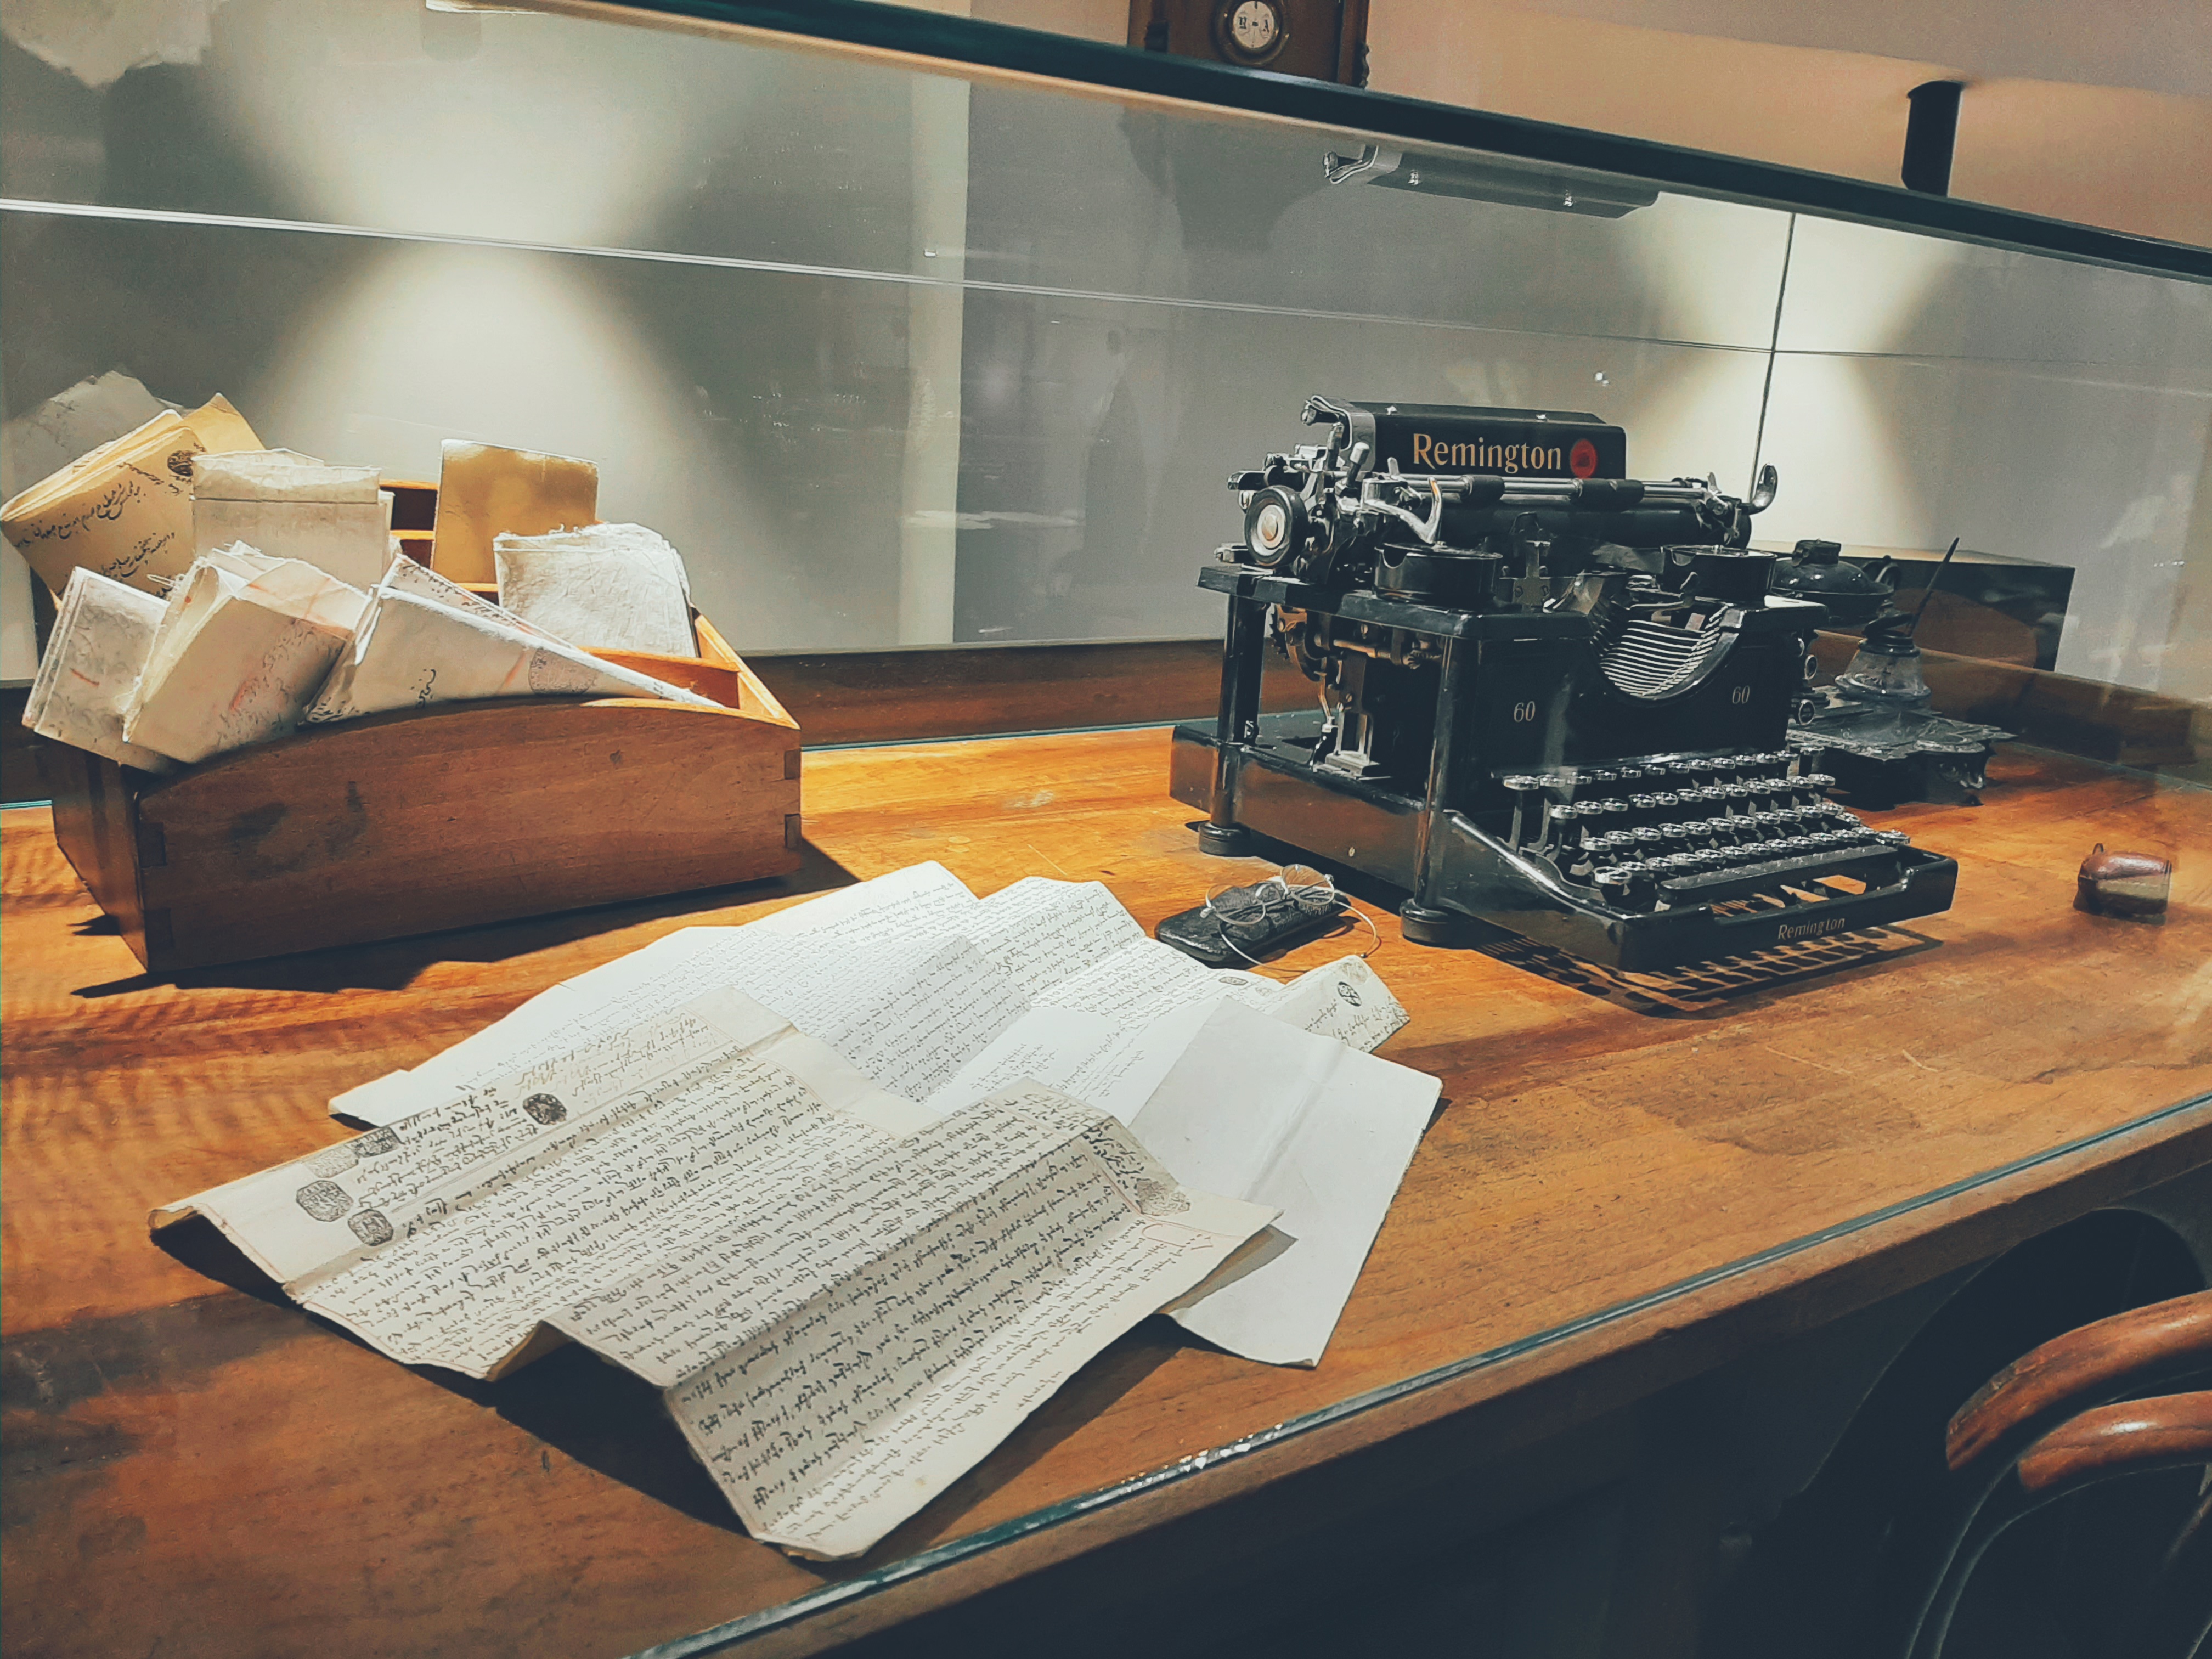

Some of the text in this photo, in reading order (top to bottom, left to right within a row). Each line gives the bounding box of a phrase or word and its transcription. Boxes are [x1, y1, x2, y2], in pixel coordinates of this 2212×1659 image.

[1413, 433, 1561, 474] Remington
[1731, 686, 1751, 705] 60
[1513, 701, 1536, 723] 60
[1778, 918, 1846, 940] Remington
